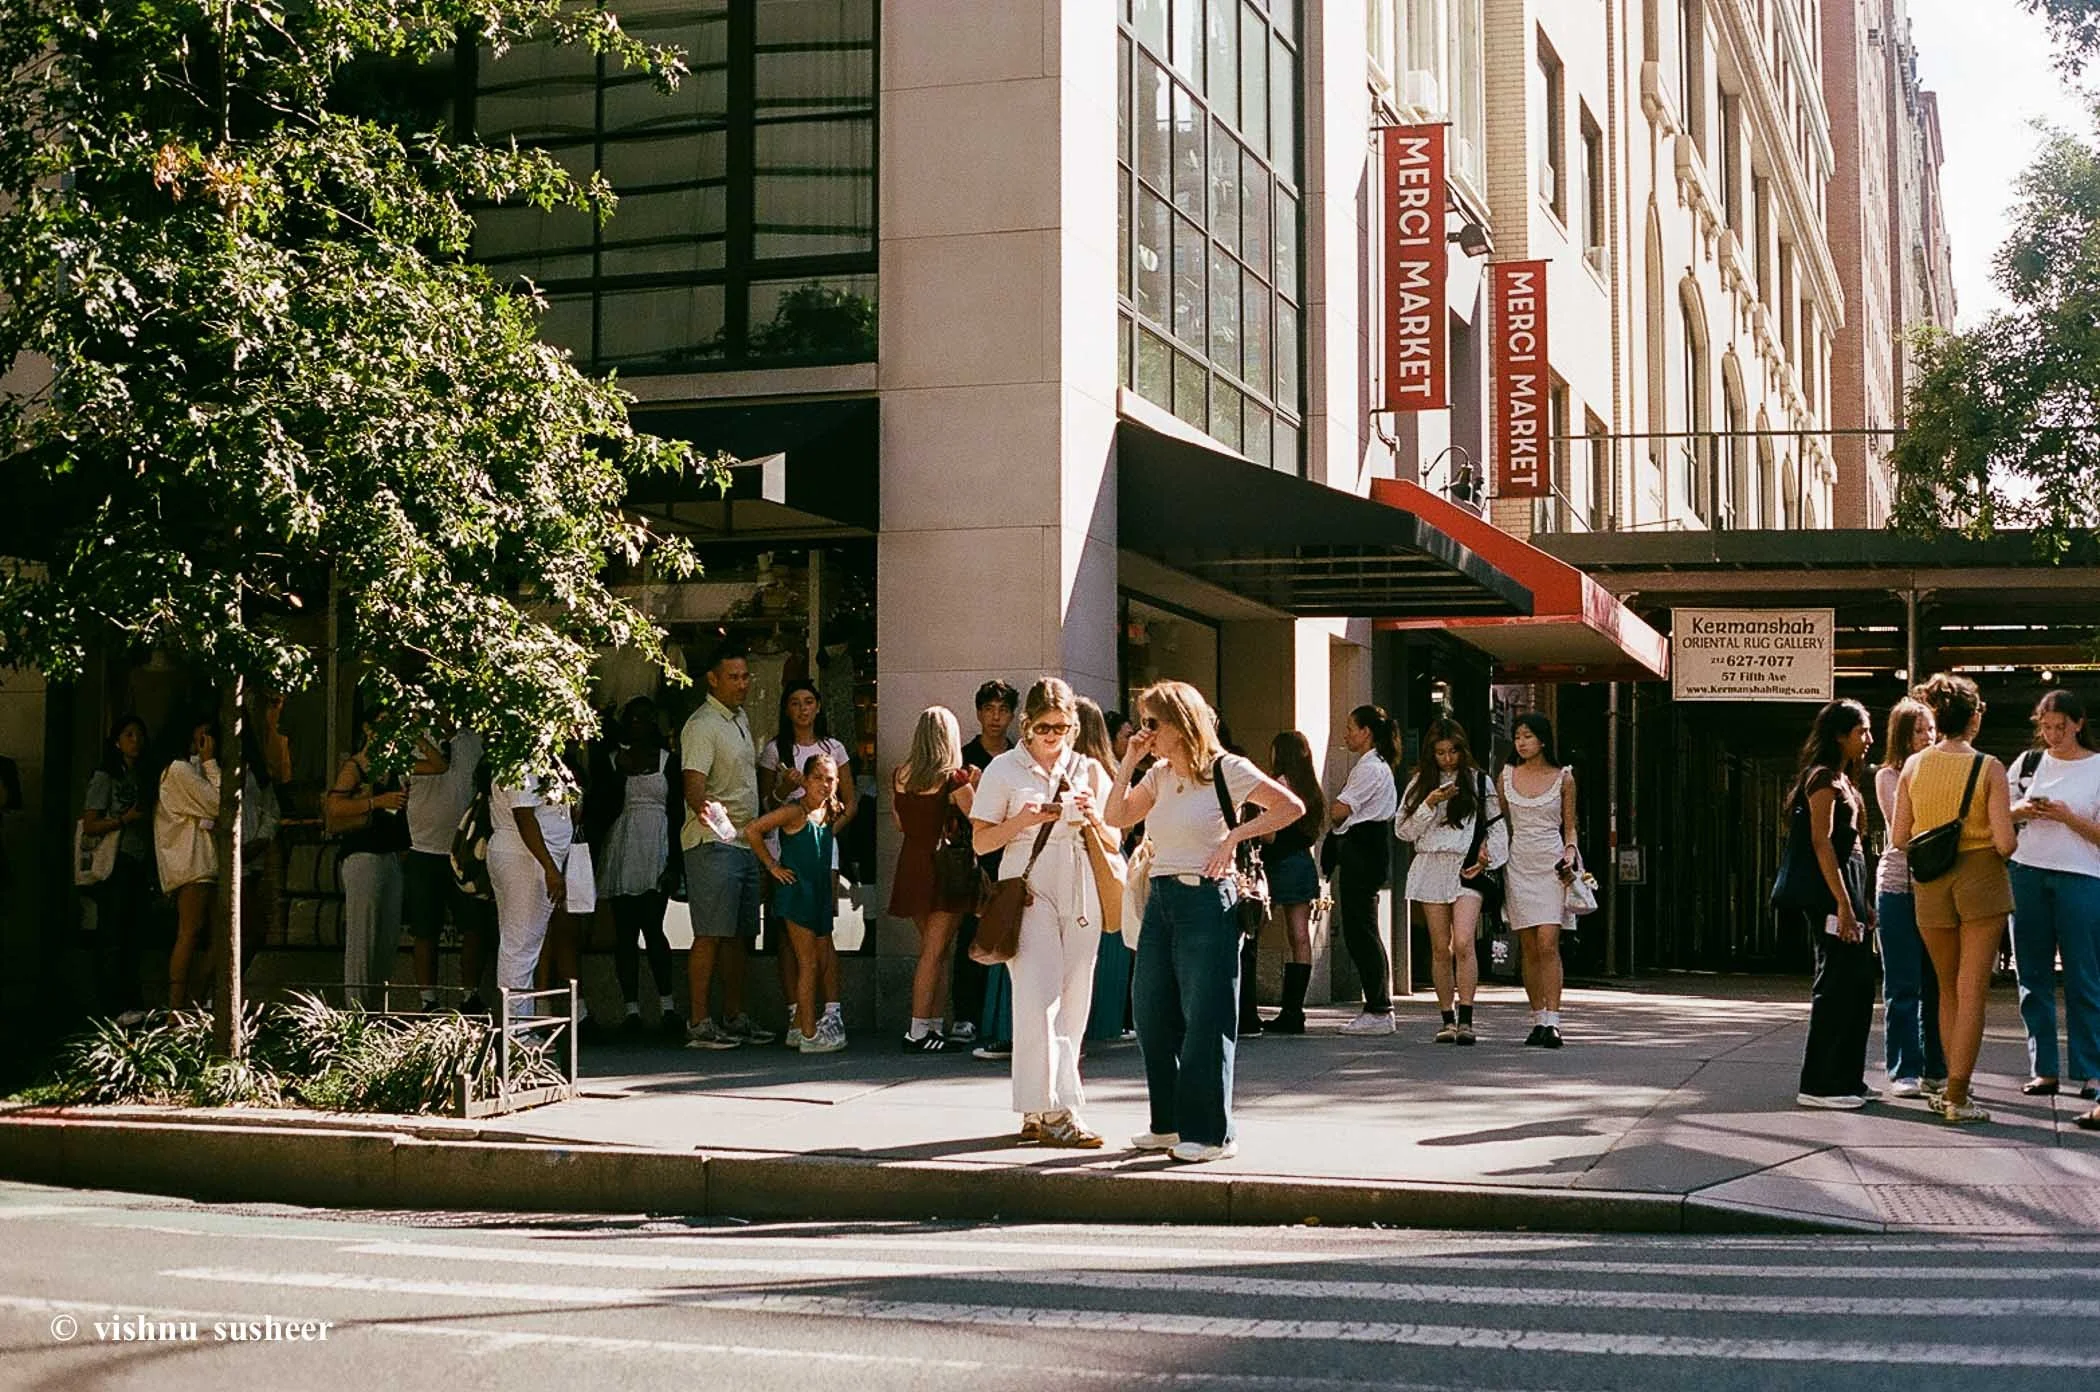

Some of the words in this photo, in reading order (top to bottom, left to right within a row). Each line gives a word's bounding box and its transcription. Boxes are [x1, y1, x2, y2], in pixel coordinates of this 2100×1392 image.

[1398, 137, 1431, 246] MERCI
[1507, 271, 1536, 362] MERCI
[1398, 260, 1431, 398] MARKET
[1509, 374, 1538, 488] MARKET
[1692, 617, 1815, 635] Kermanshah
[1682, 637, 1740, 650] ORIENTAL
[1745, 637, 1771, 650] RUG
[1774, 637, 1825, 650] GALLERY
[1726, 655, 1795, 667] 627-7077
[1721, 672, 1736, 682] 57
[1739, 672, 1765, 682] Fifth
[1768, 672, 1787, 682] Ave
[1686, 685, 1820, 695] www.KermanshahRugs.com
